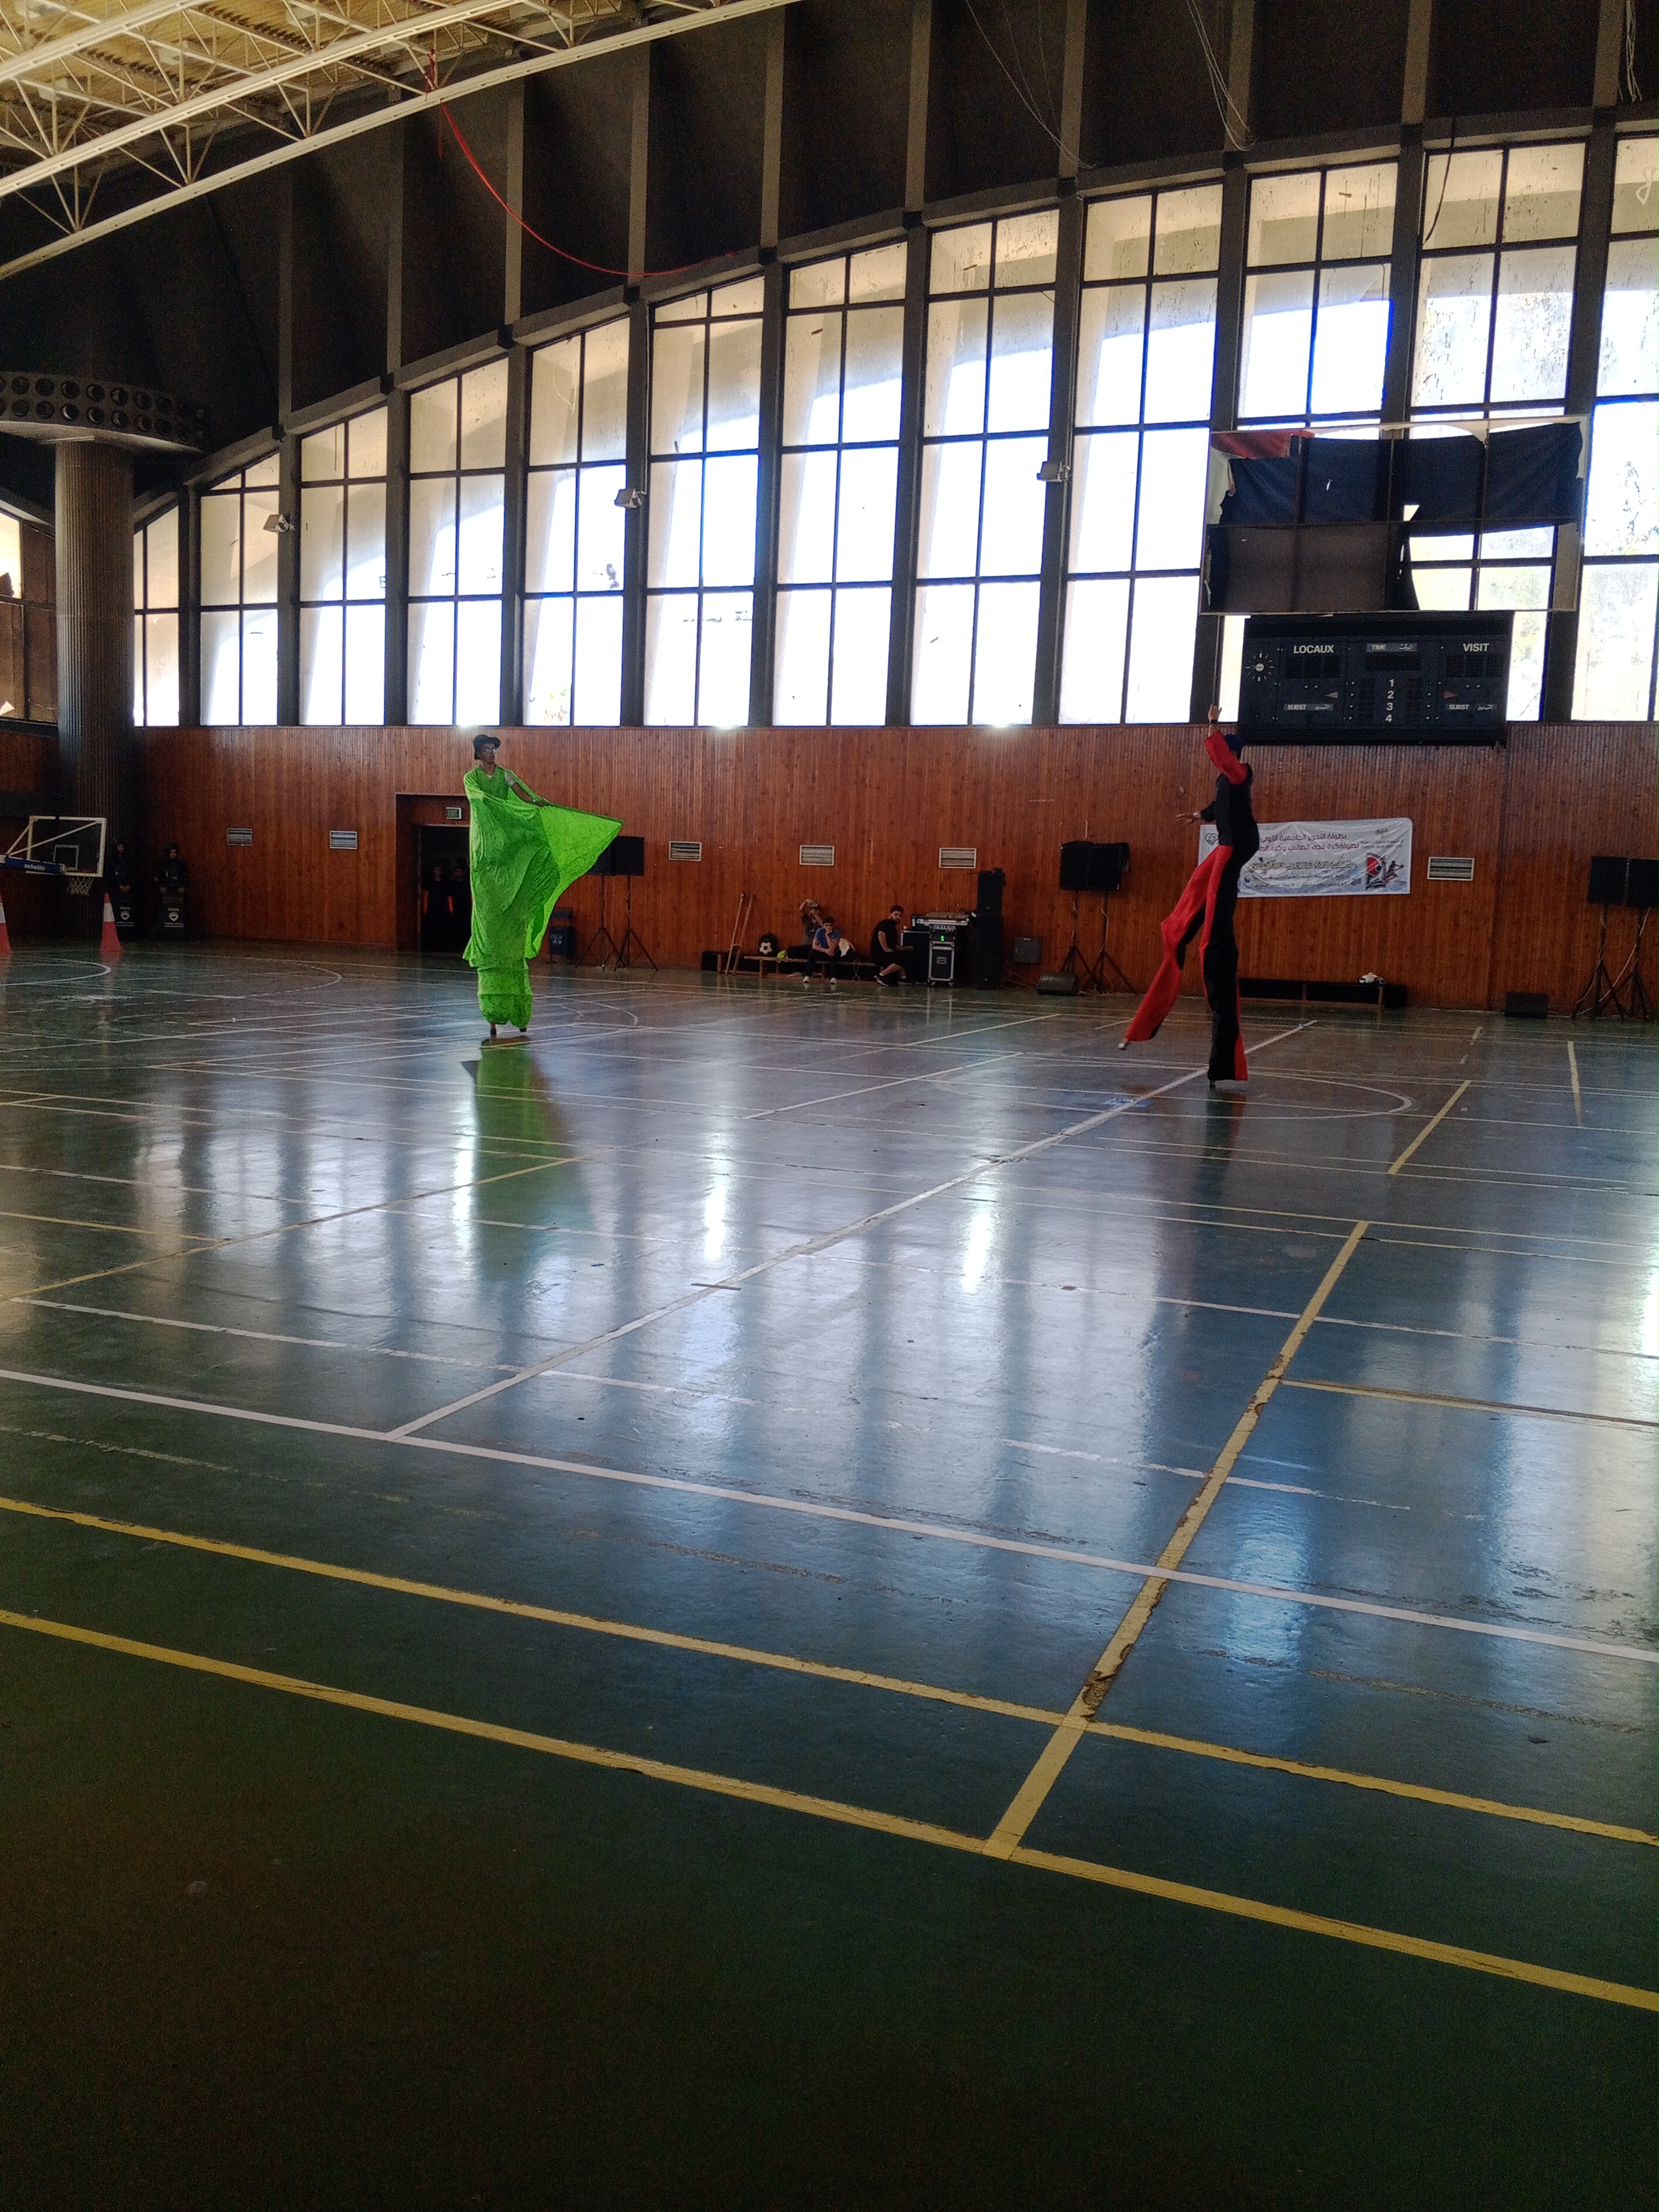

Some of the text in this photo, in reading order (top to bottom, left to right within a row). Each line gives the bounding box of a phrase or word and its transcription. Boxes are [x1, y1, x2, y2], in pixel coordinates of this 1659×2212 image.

[1293, 644, 1335, 654] LOCAUX
[1463, 643, 1490, 652] VISIT
[1388, 679, 1394, 688] 1
[1387, 690, 1394, 699] 2
[1386, 702, 1393, 711] 3
[1385, 714, 1392, 723] 4
